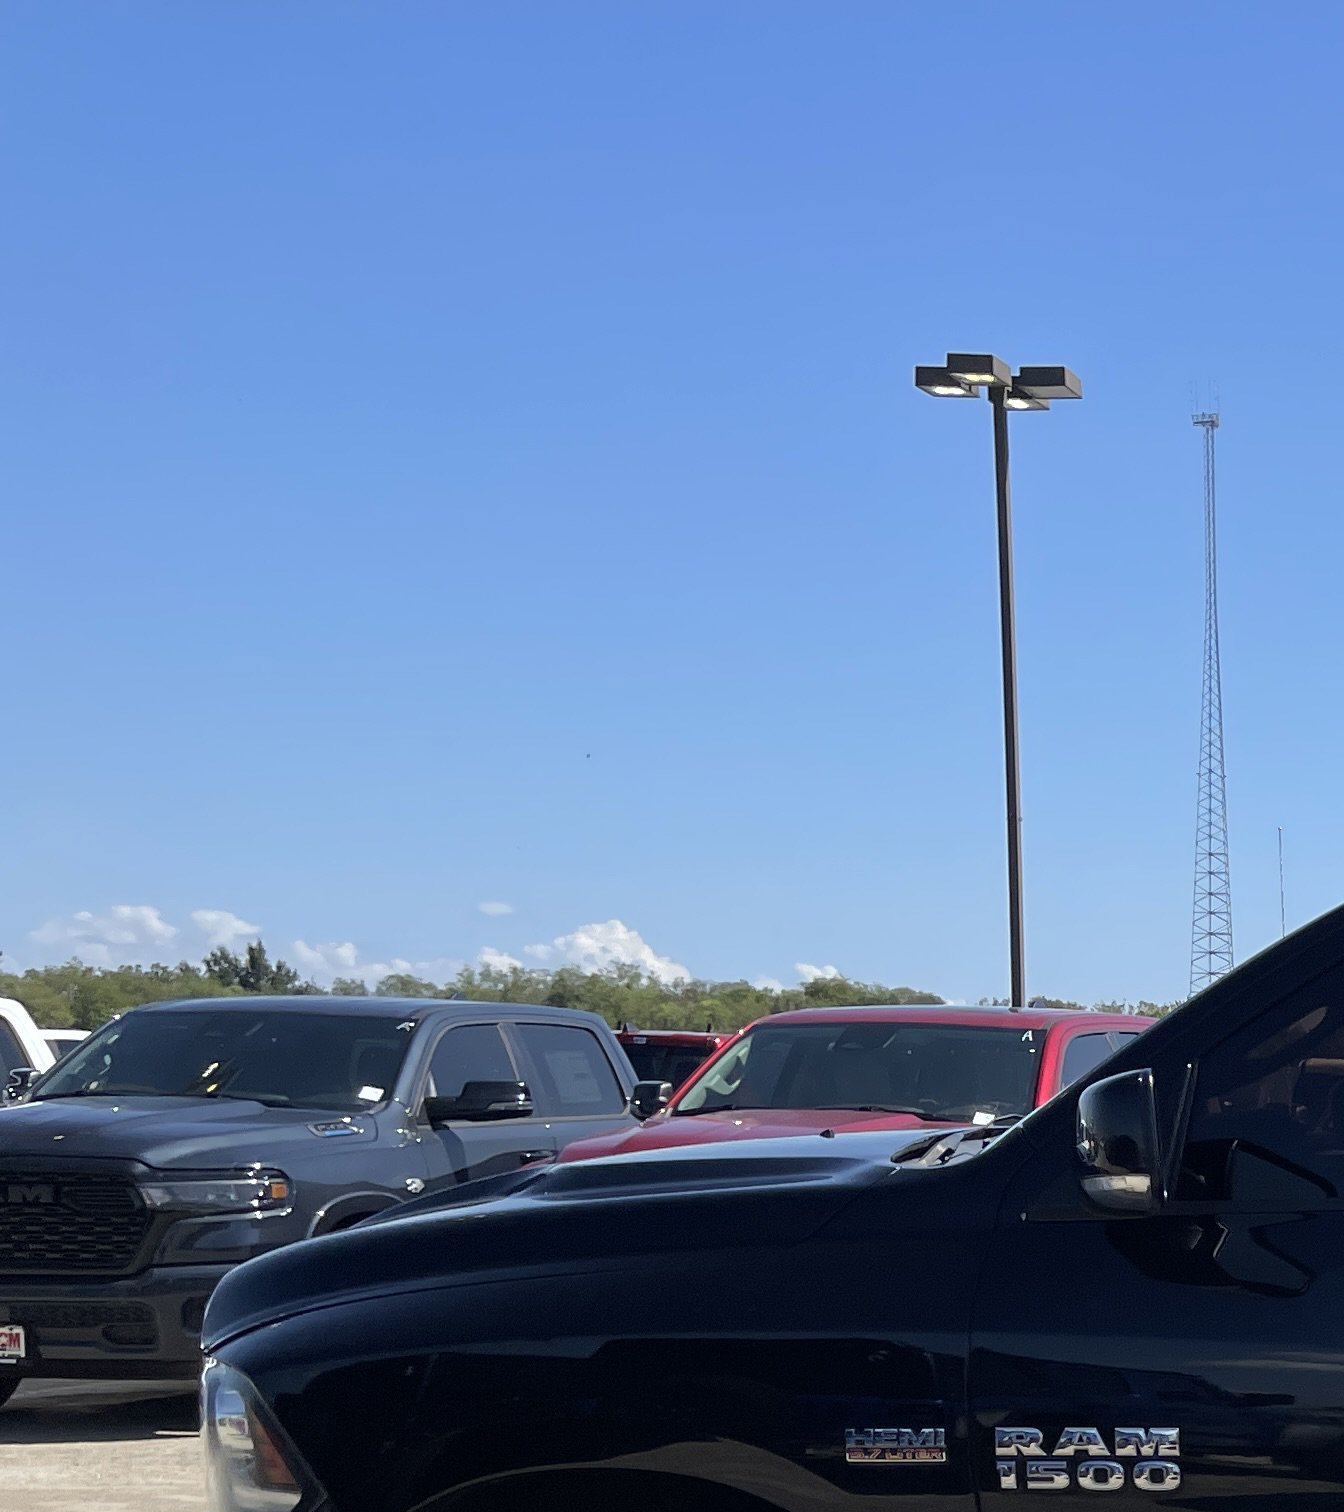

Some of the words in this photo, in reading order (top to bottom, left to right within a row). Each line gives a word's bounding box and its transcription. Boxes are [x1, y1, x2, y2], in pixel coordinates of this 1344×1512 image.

[845, 1428, 946, 1446] HEMI
[995, 1427, 1181, 1456] RAM
[996, 1460, 1181, 1491] 1500
